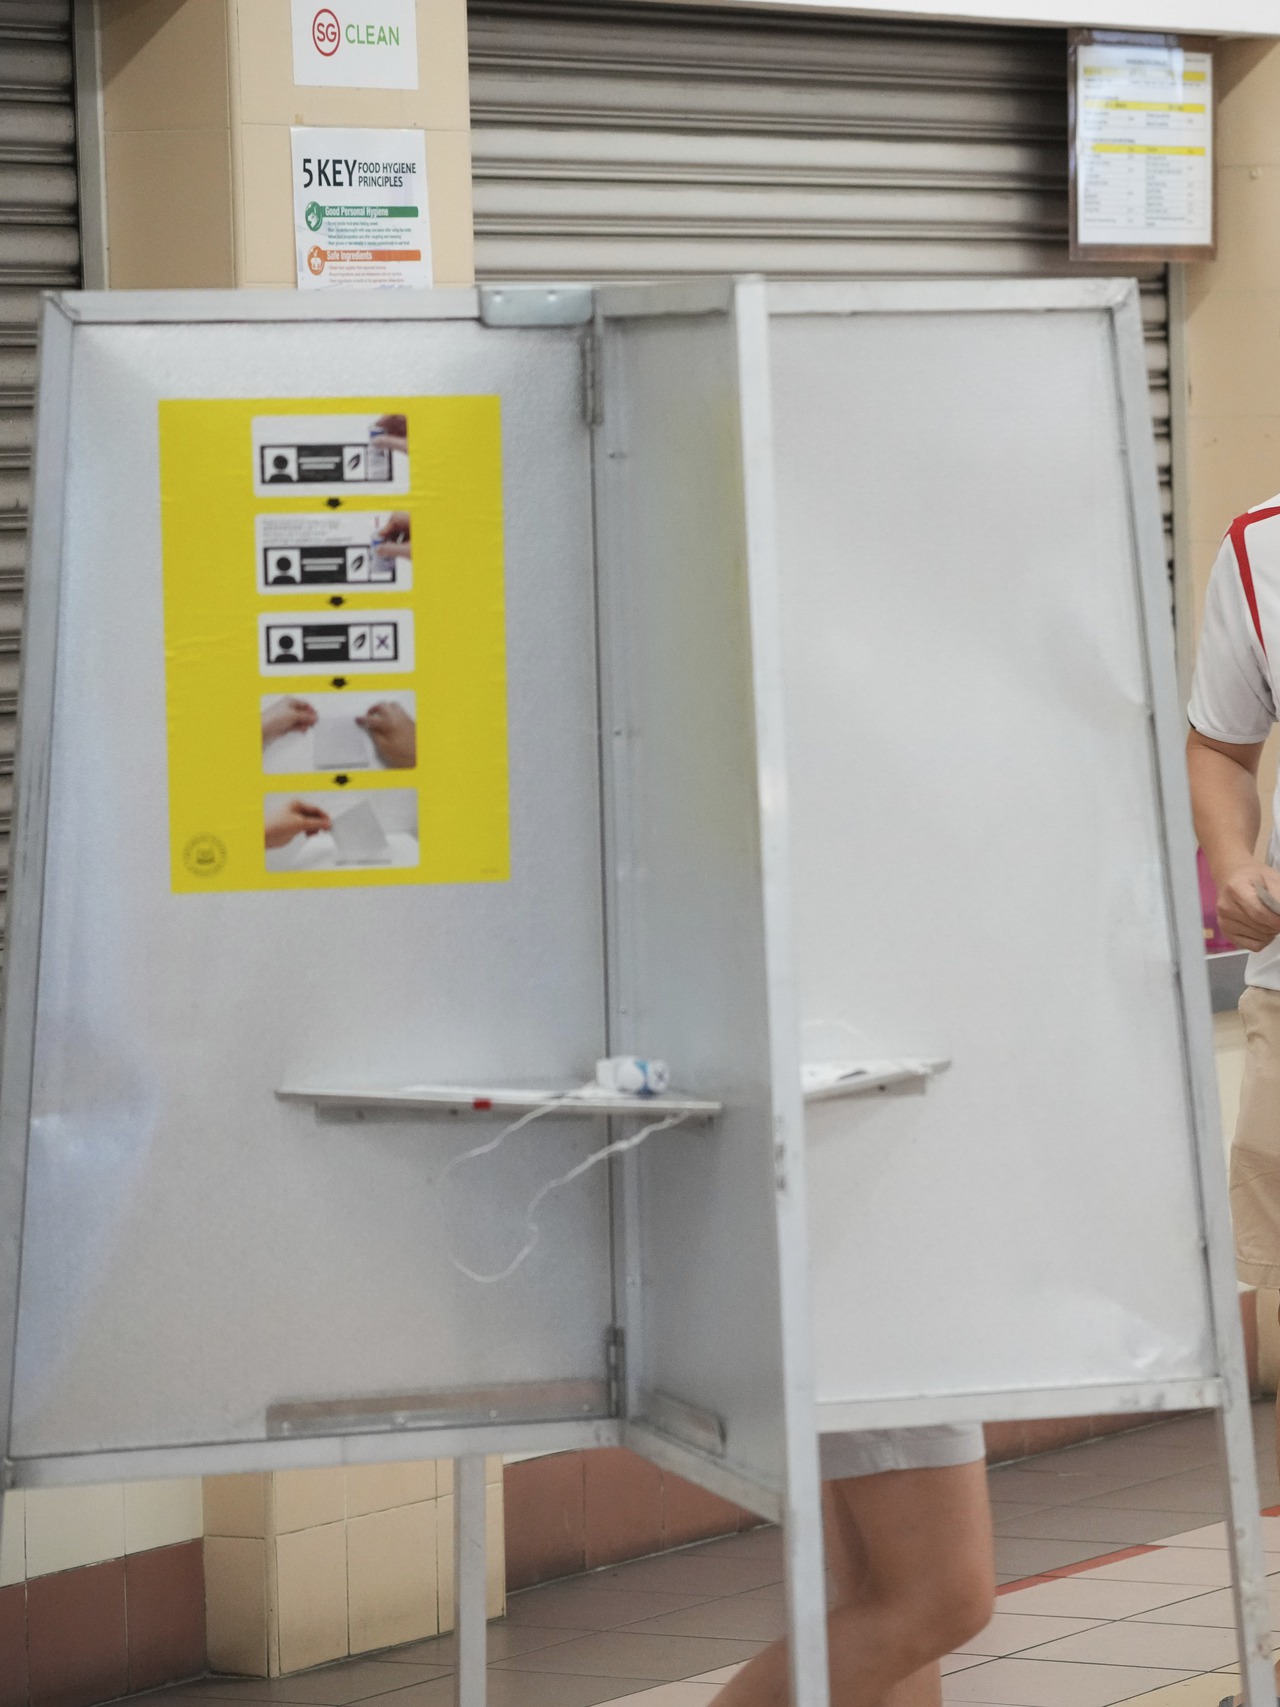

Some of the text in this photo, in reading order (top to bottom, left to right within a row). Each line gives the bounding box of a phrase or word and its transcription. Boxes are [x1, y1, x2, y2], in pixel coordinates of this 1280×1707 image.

[317, 22, 399, 46] SG CLEAN
[303, 158, 357, 188] 5 KEY
[358, 162, 416, 174] FOOD HYGIENE
[358, 176, 403, 188] PRINCIPLES
[325, 207, 389, 218] Good Personal Hygiene
[326, 251, 373, 262] Safe Ingredients
